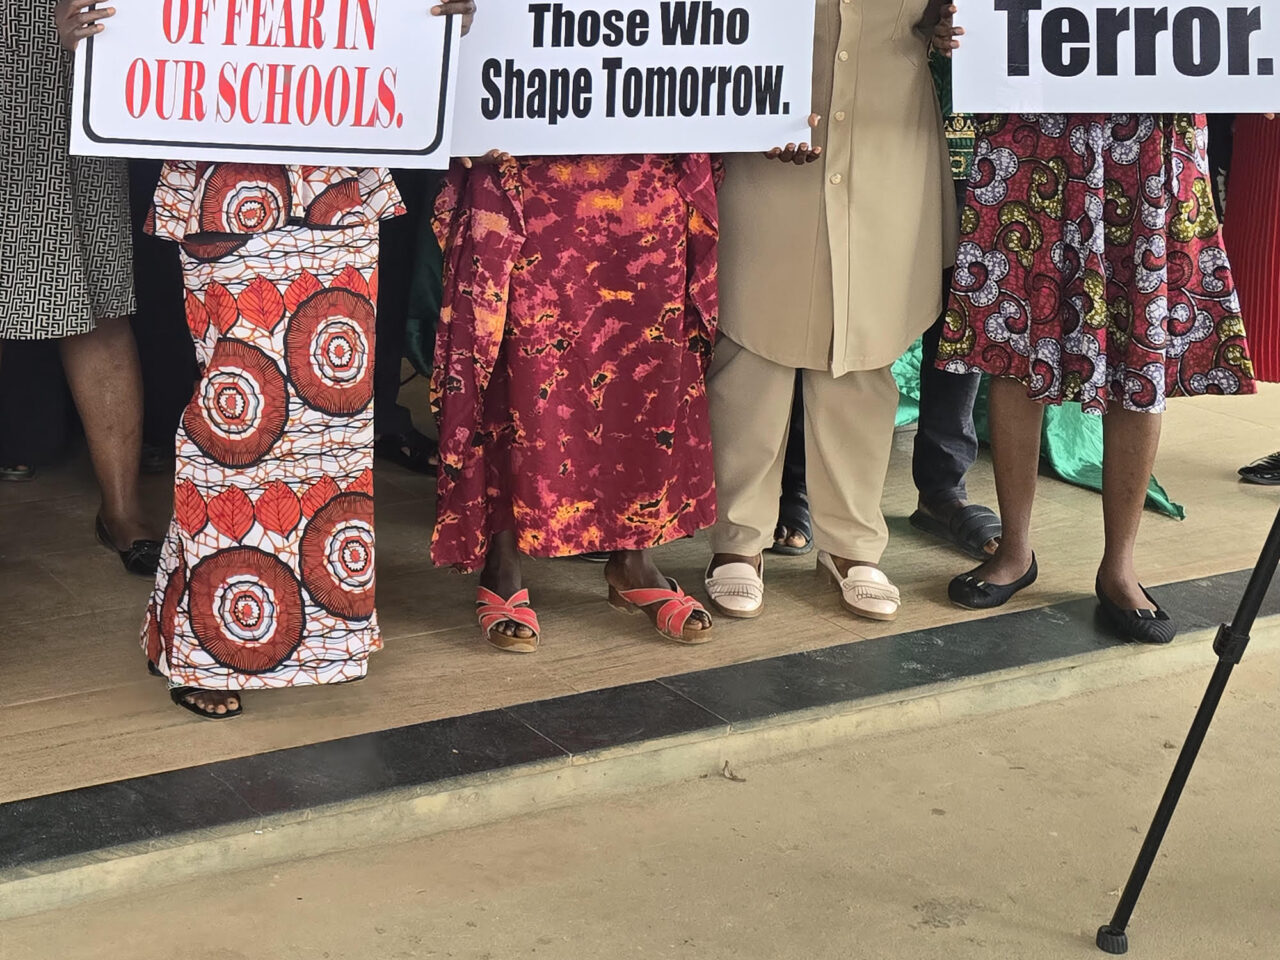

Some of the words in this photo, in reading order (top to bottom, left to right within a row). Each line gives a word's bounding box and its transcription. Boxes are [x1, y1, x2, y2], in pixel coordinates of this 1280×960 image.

[528, 3, 650, 48] Those
[660, 0, 750, 46] Who
[125, 57, 206, 122] OUR
[215, 61, 403, 129] SCHOOLS.
[480, 57, 593, 125] Shape
[601, 57, 791, 119] Tomorrow.
